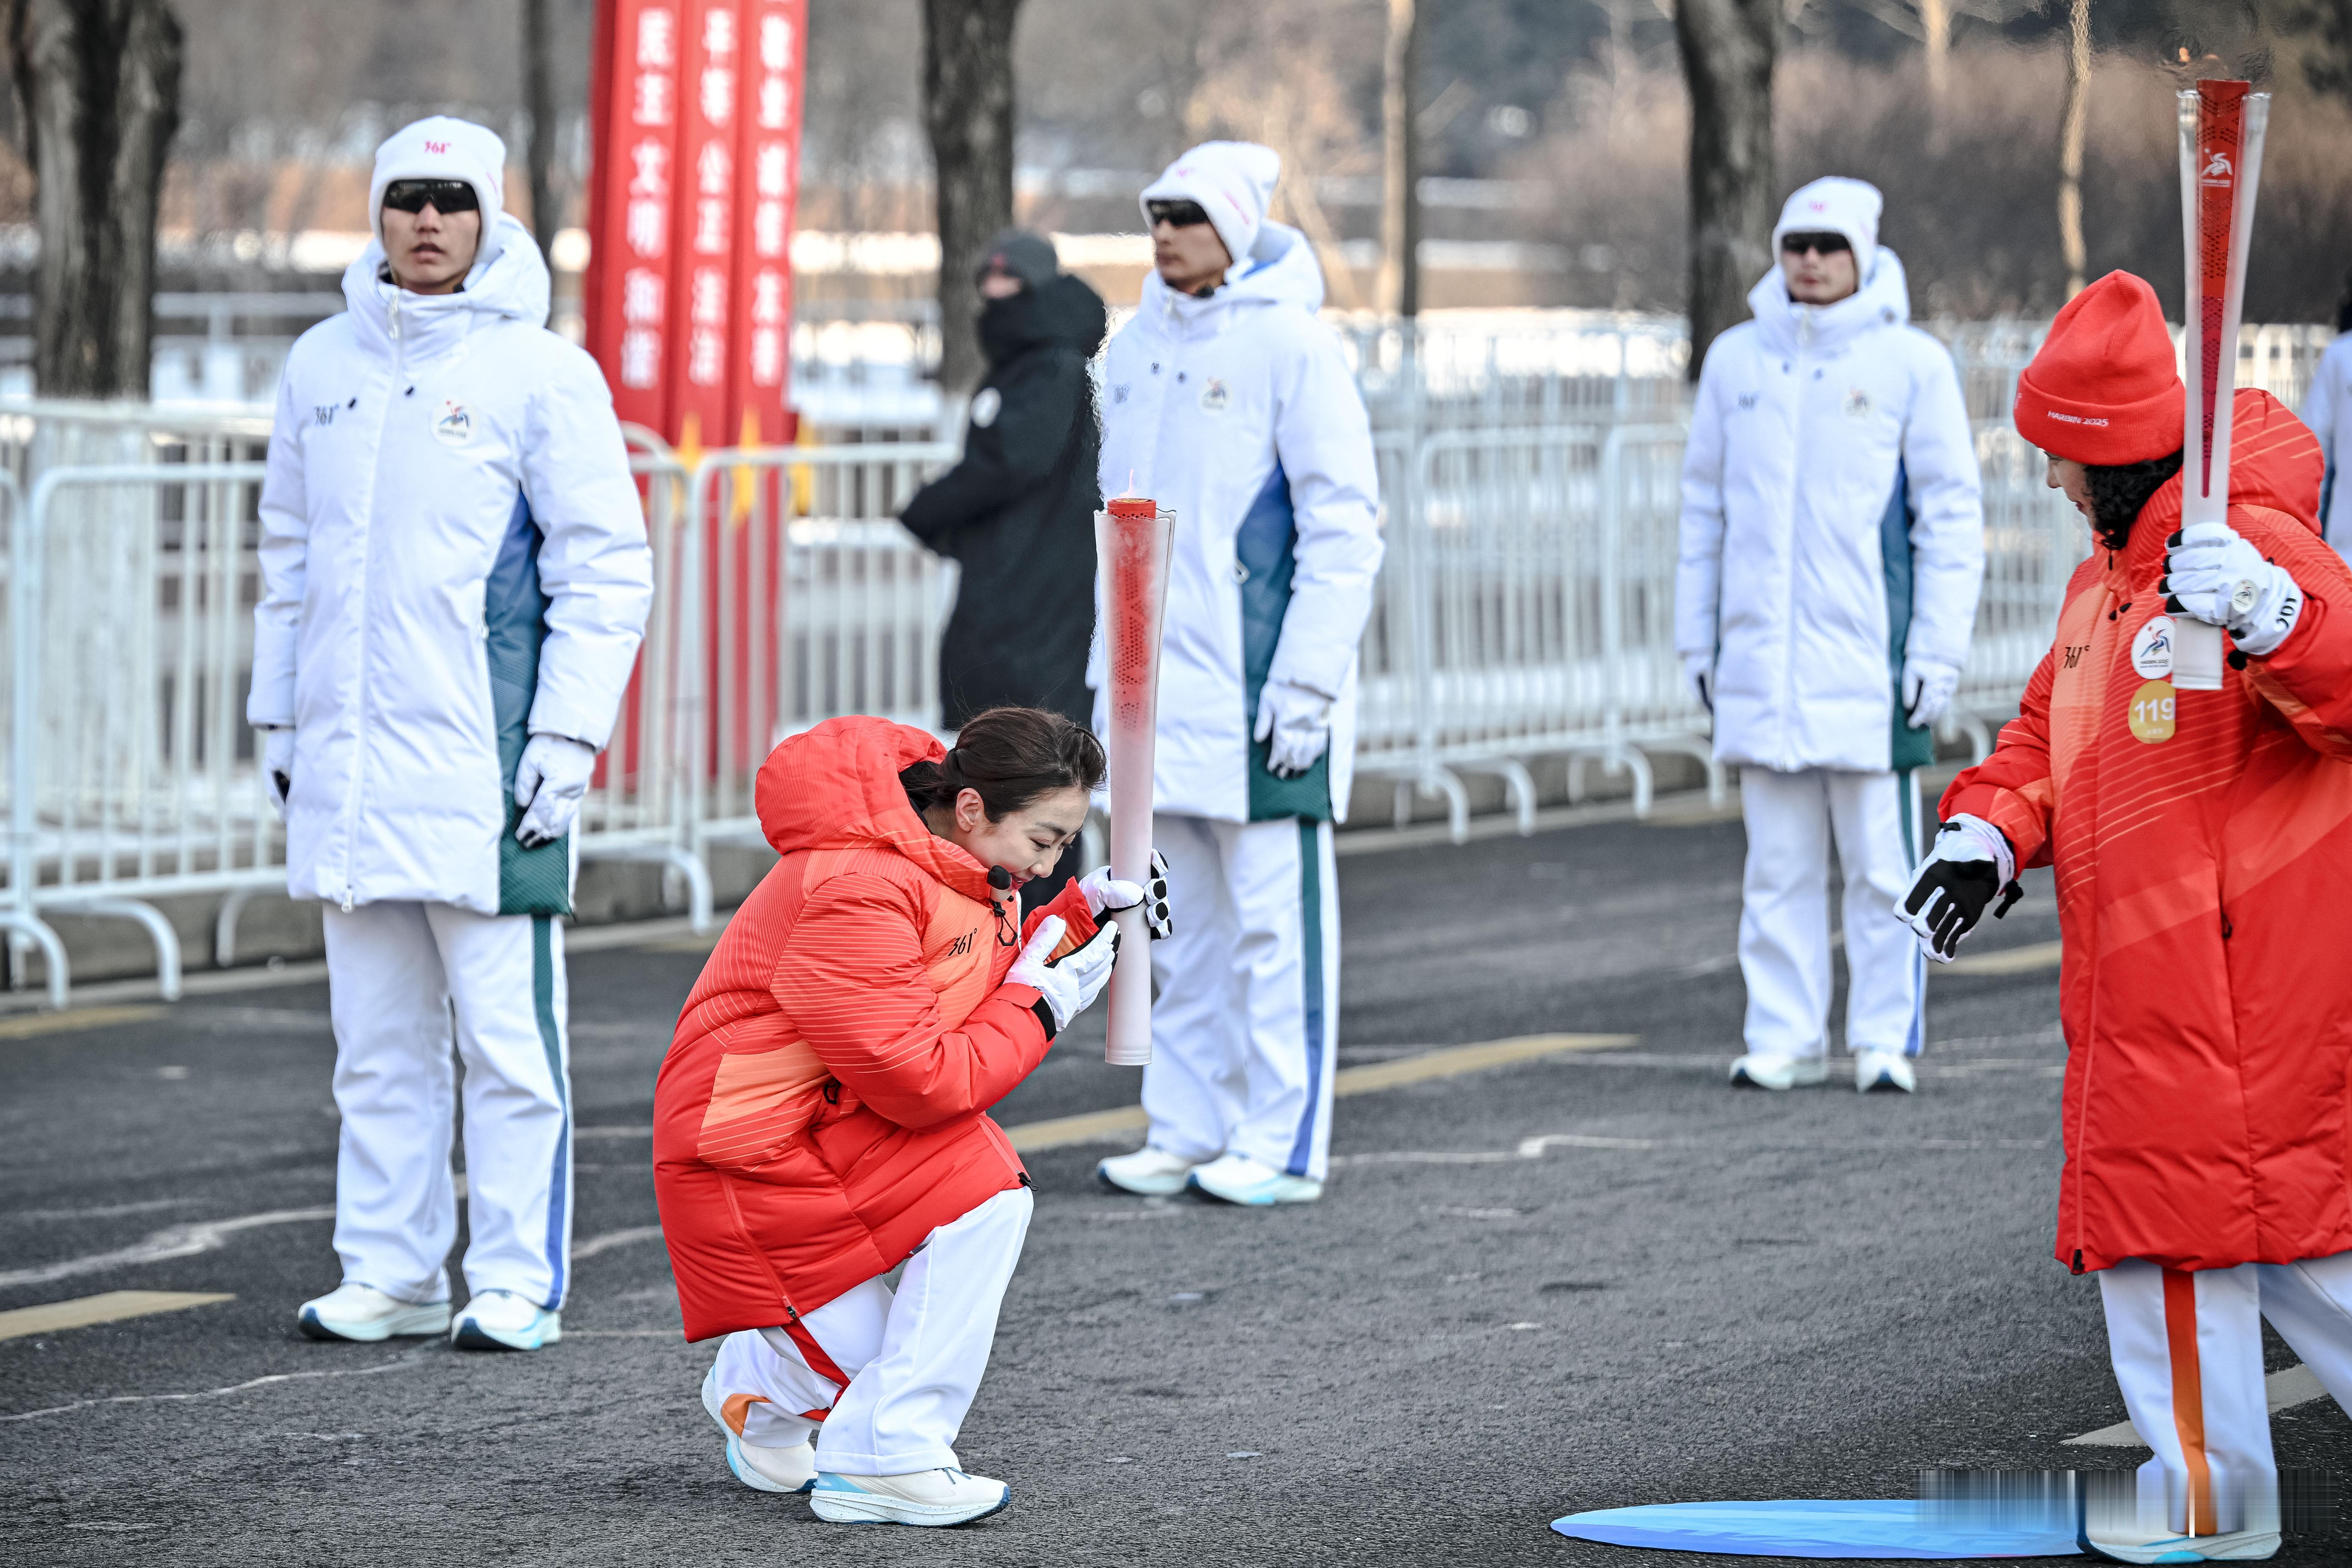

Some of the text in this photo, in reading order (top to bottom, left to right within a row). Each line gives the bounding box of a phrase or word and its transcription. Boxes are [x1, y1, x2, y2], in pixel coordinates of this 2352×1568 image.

[2047, 410, 2109, 427] HARBIN 2025
[2135, 698, 2175, 723] 119
[947, 928, 977, 957] 361°
